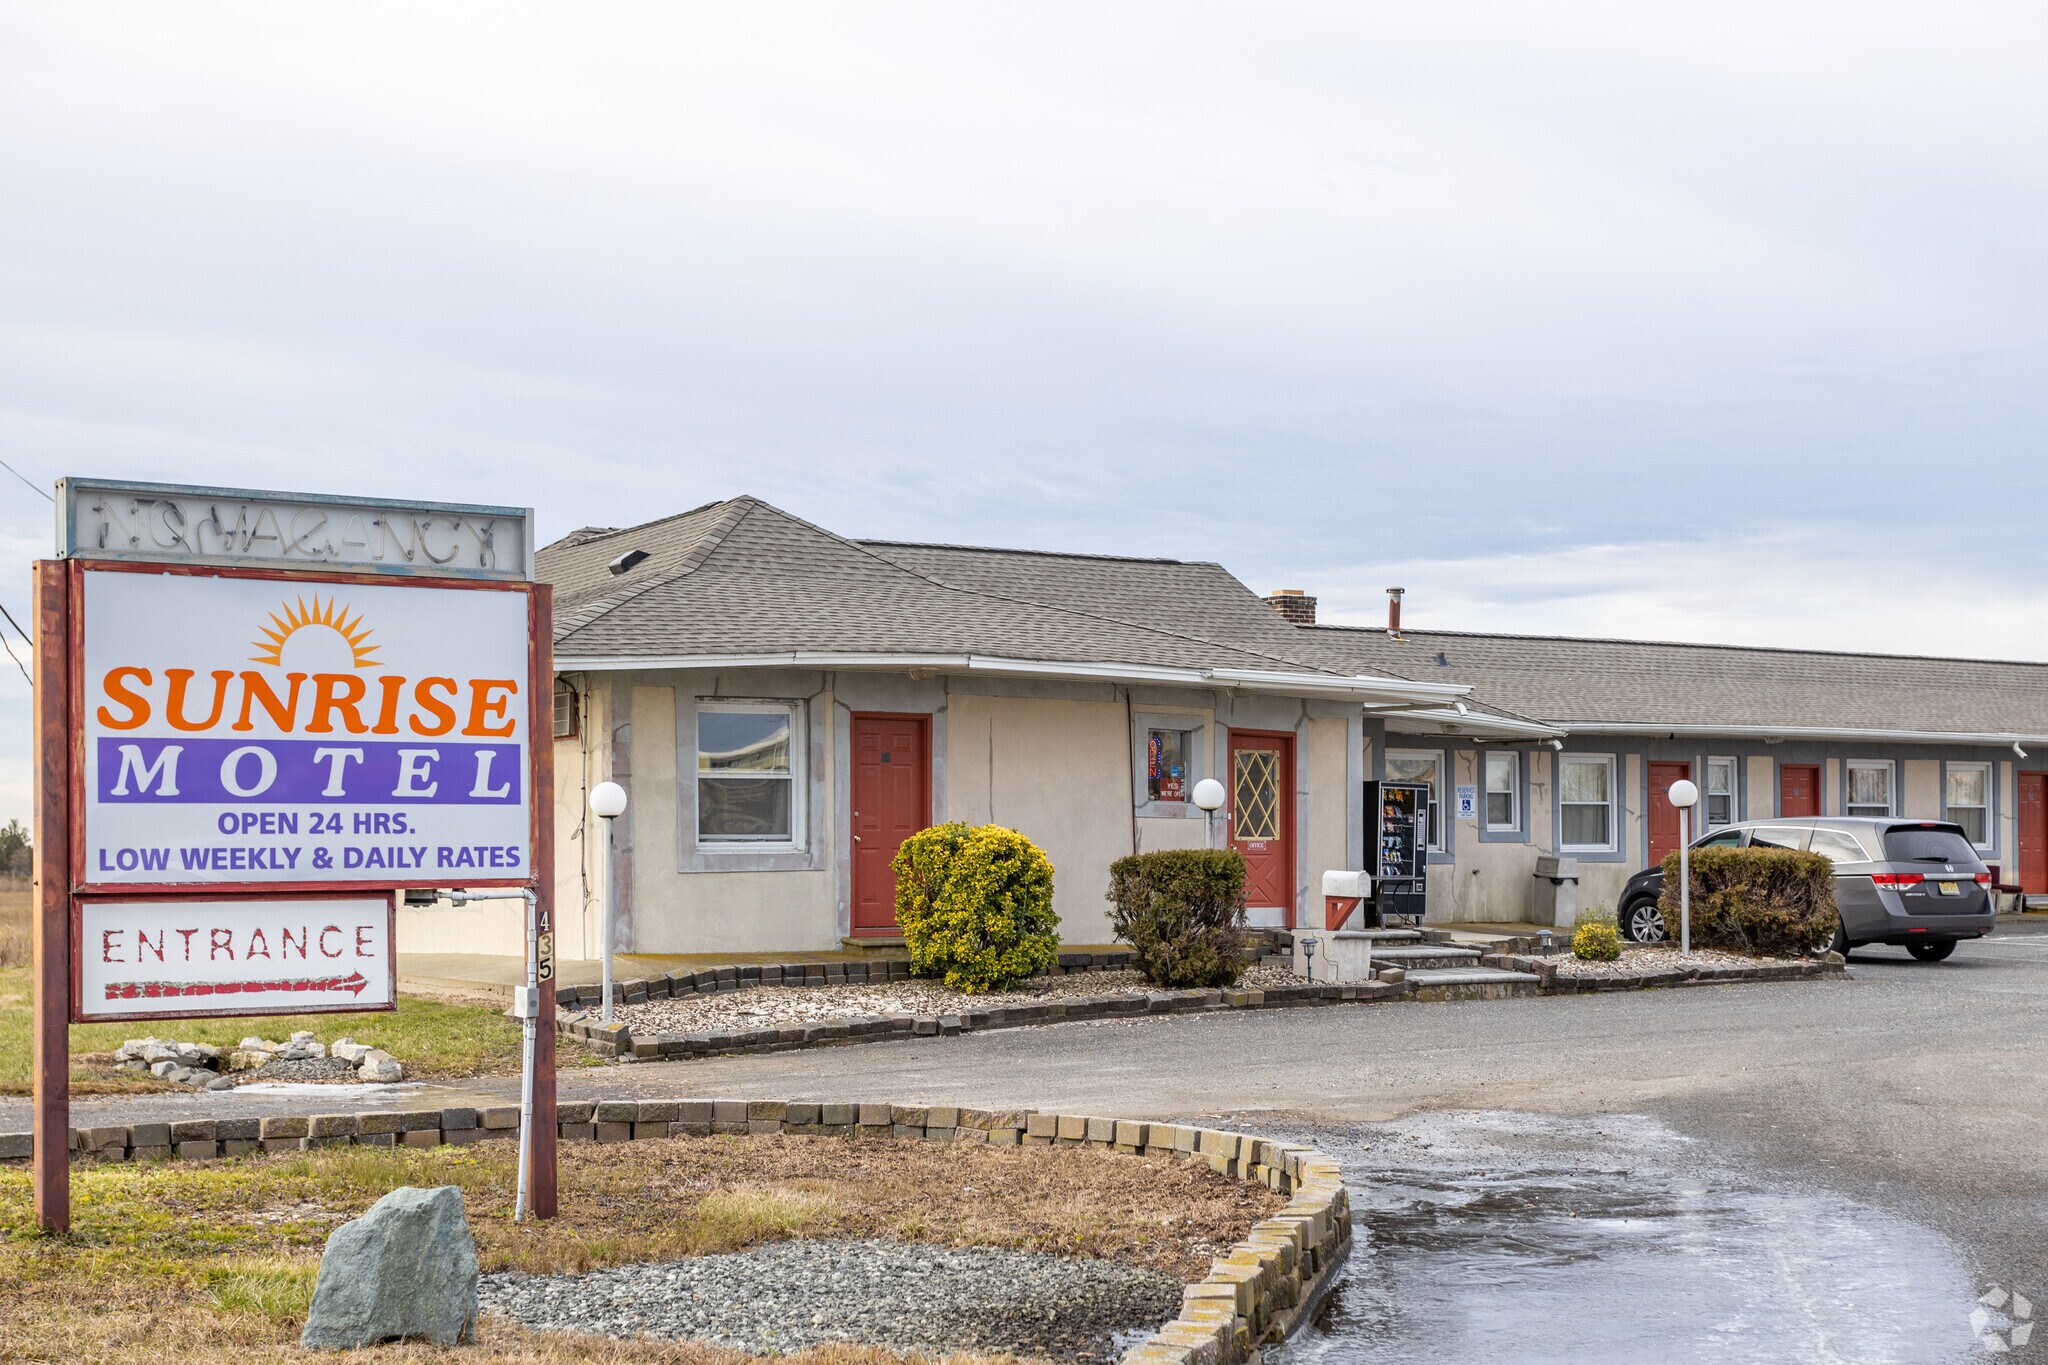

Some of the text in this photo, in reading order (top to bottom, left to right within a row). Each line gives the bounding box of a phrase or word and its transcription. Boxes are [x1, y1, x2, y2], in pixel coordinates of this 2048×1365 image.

[98, 498, 497, 567] NO VACANCY
[97, 666, 518, 738] SUNRISE
[110, 744, 511, 799] MOTEL
[1149, 739, 1157, 777] OPEN
[1167, 782, 1179, 790] YES
[217, 811, 416, 835] OPEN 24 HRS.
[99, 845, 521, 872] LOW WEEKLY & DAILY RATES
[102, 925, 375, 963] ENTRANCE
[539, 910, 552, 979] 435
